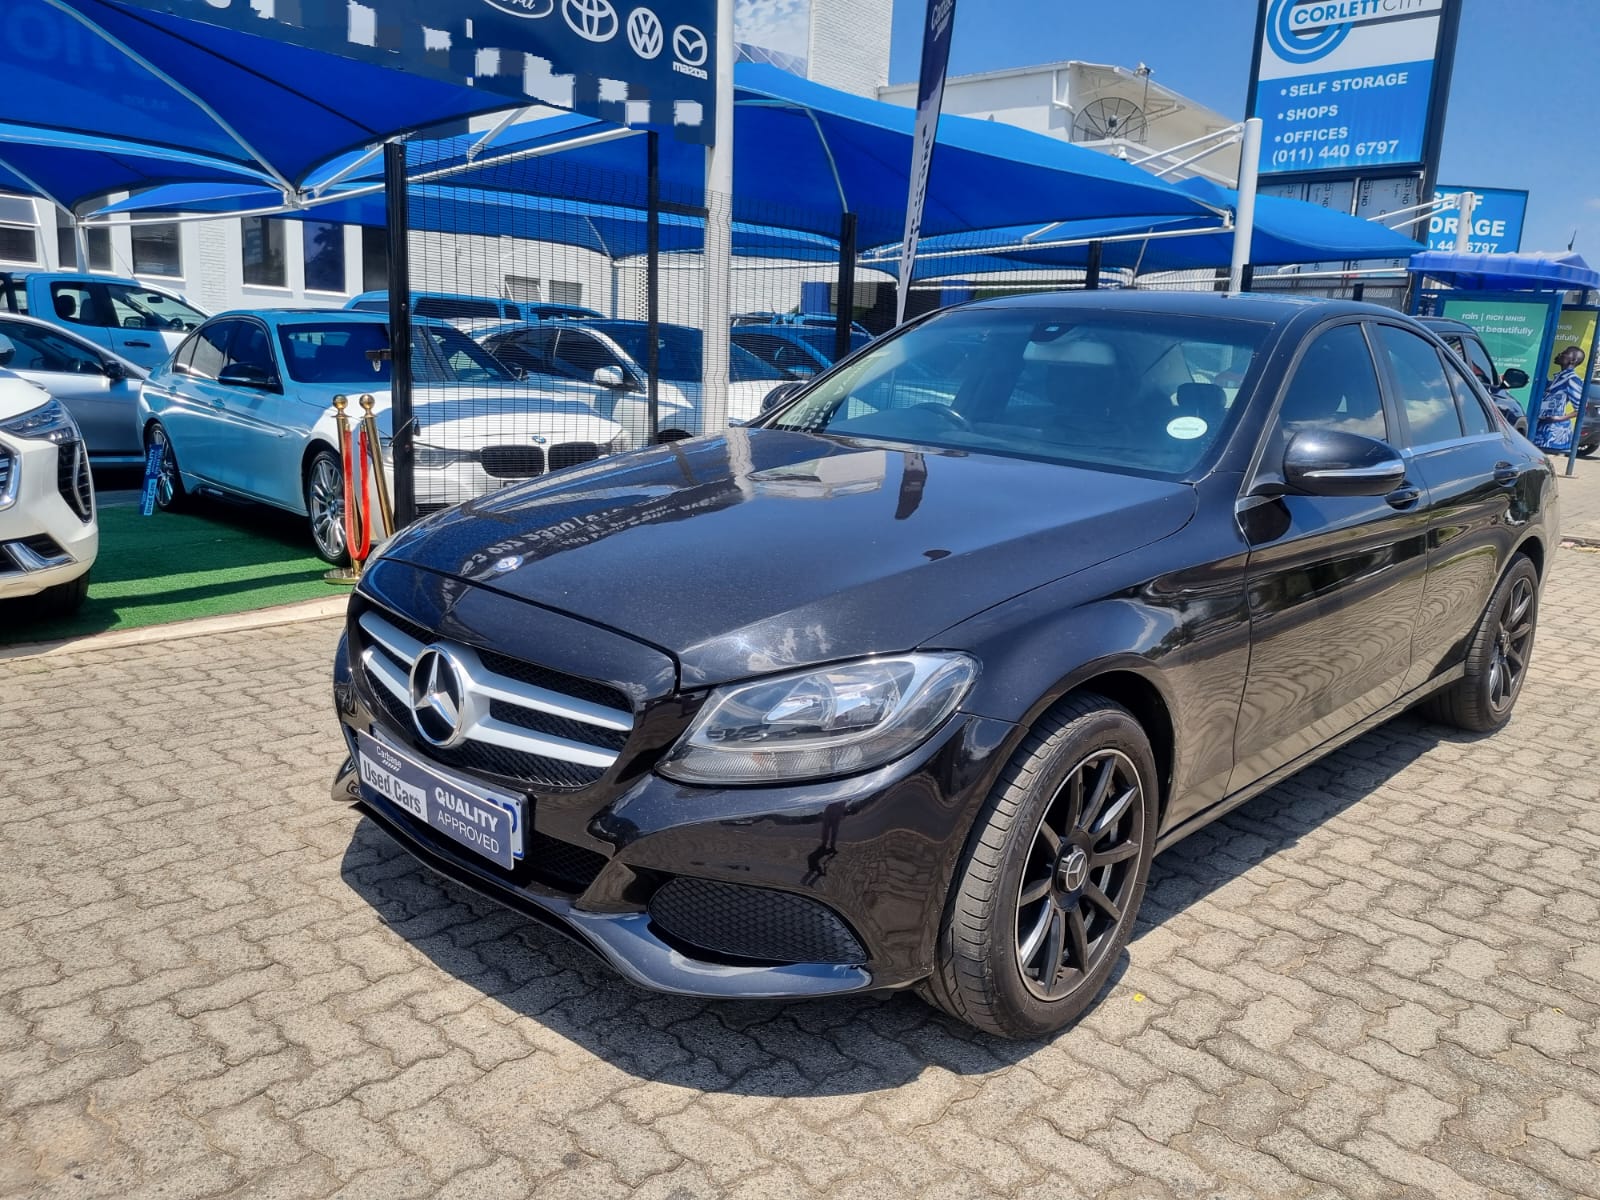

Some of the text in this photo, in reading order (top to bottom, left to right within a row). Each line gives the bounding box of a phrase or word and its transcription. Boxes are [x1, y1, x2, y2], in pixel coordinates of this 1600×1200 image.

[1289, 72, 1409, 97] SELF STORAGE
[1286, 105, 1339, 121] SHOPS
[1283, 127, 1349, 144] OFFICES
[1272, 140, 1399, 166] (011) 440 6797
[1432, 192, 1484, 211] SEF
[1429, 217, 1506, 237] ORGE
[1486, 326, 1534, 336] beautifully
[363, 759, 422, 815] Used Cars
[434, 786, 499, 832] QUALITY
[437, 810, 500, 855] APPROVED
